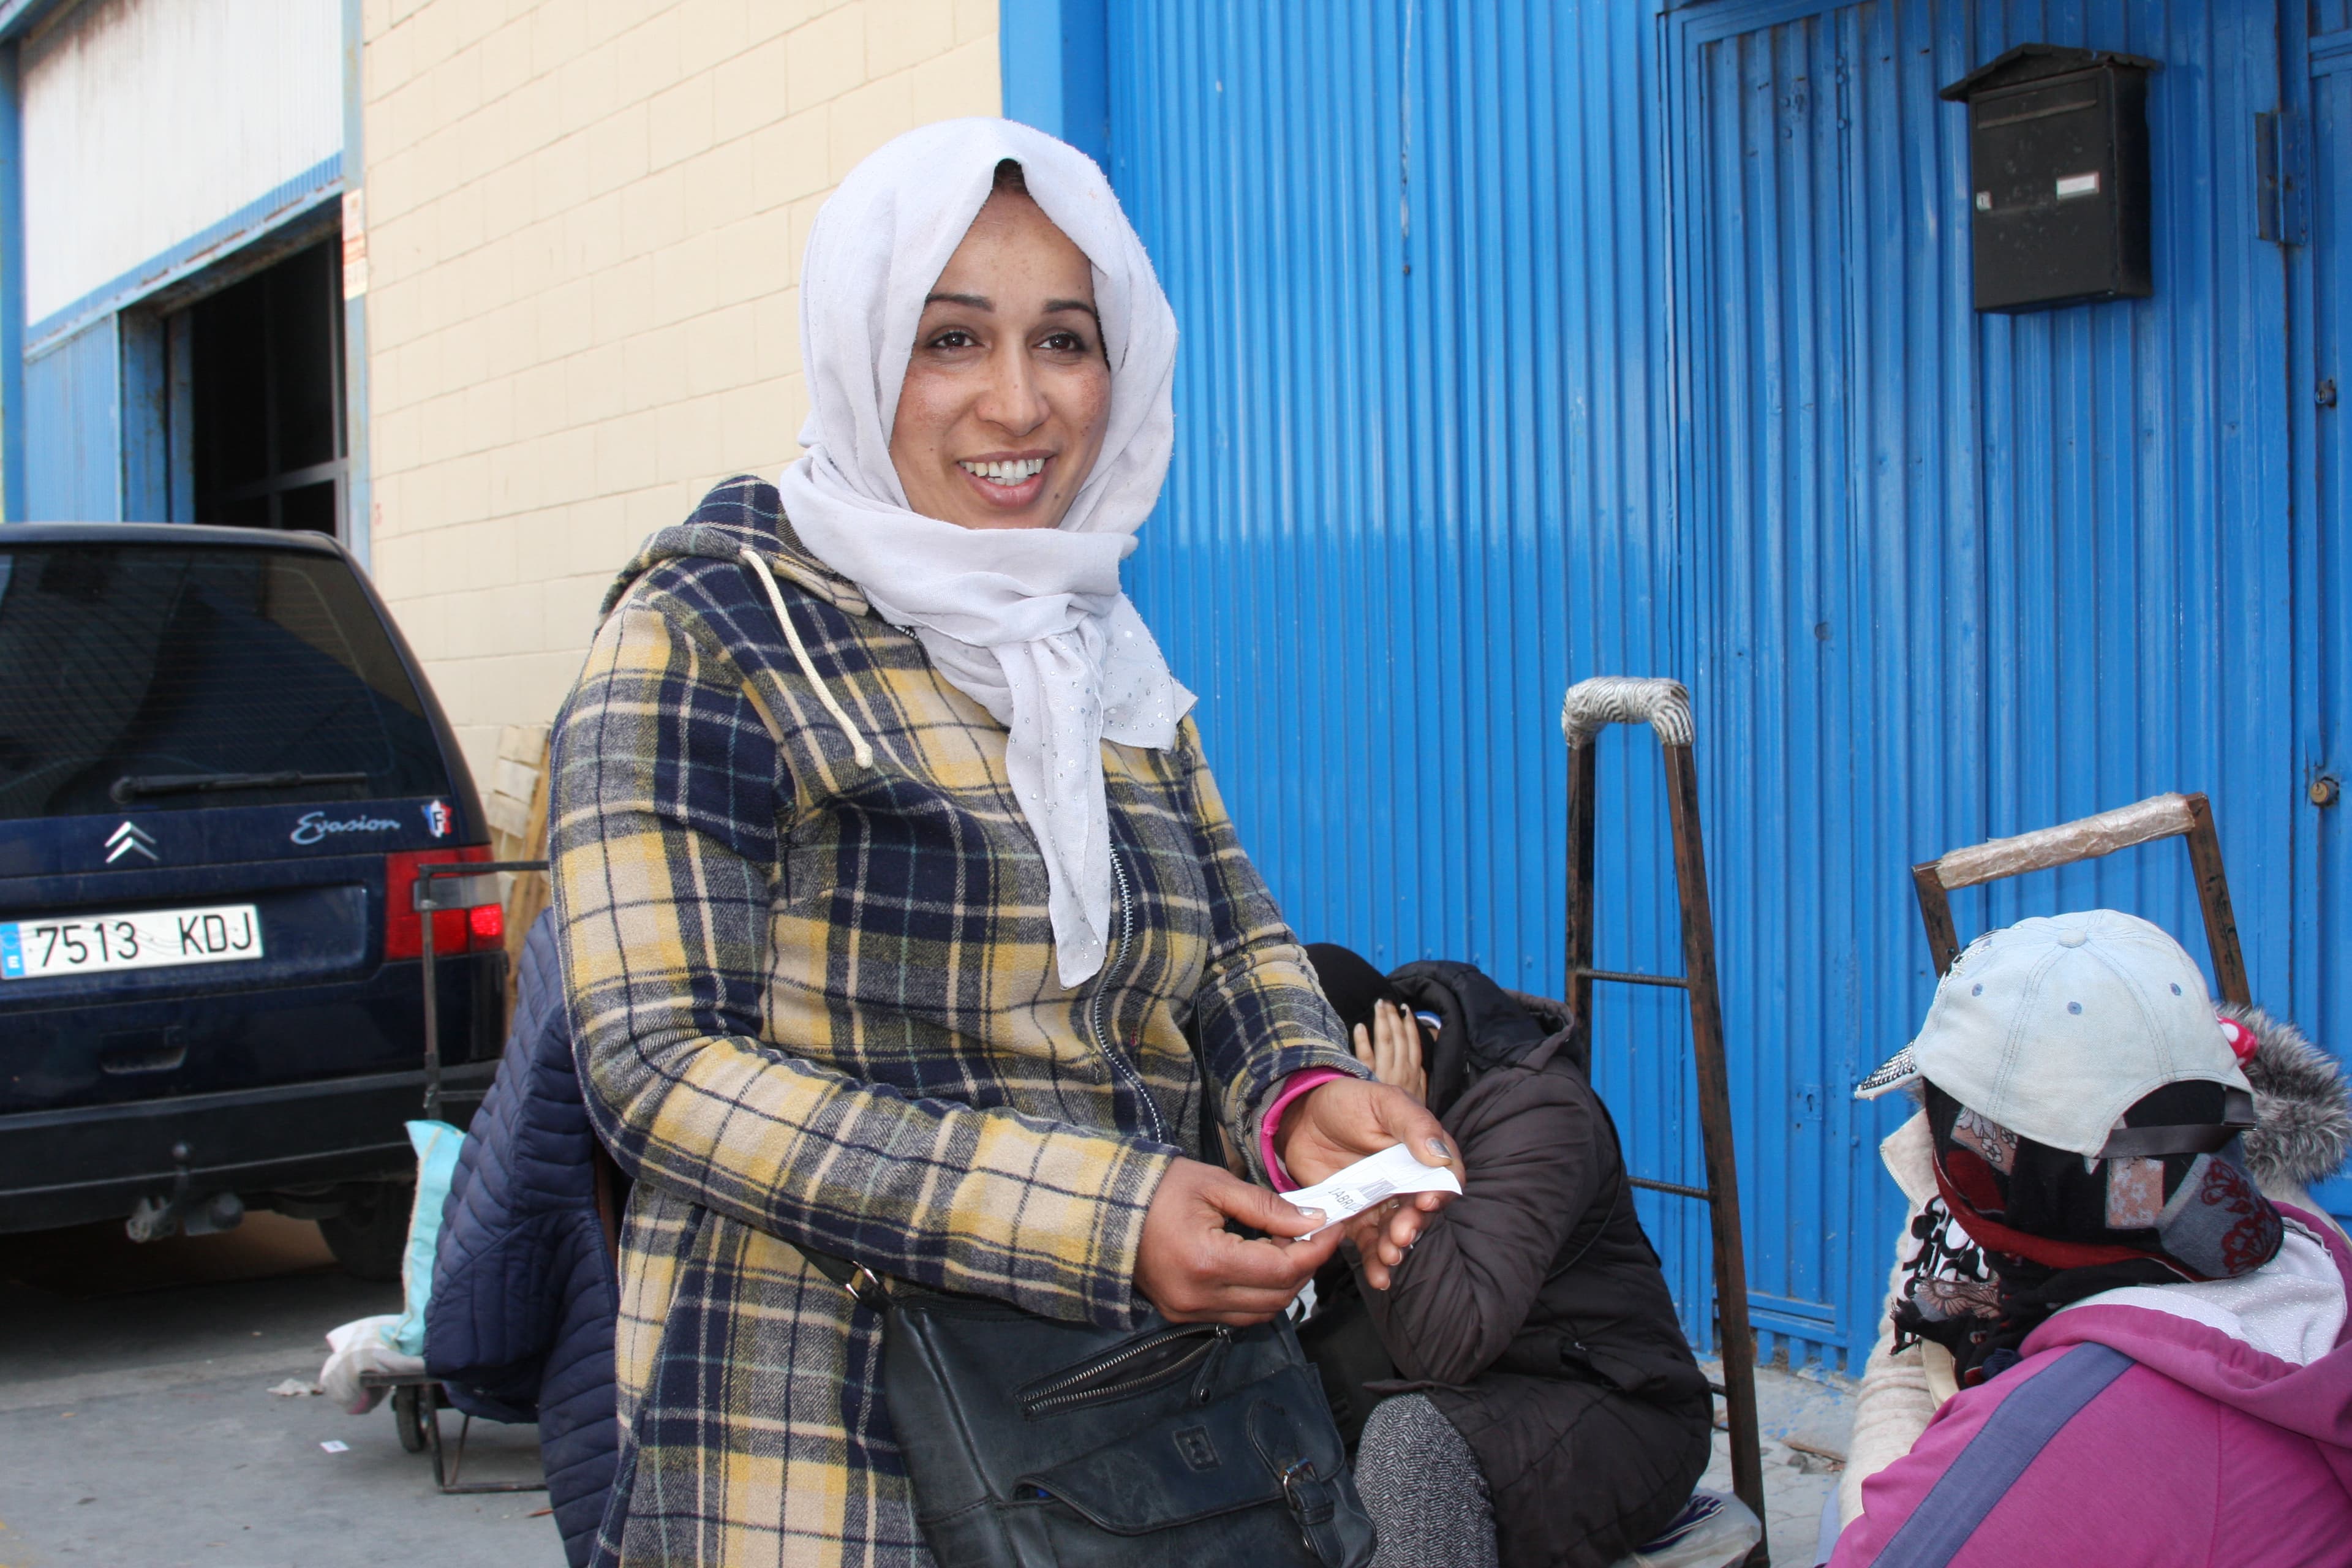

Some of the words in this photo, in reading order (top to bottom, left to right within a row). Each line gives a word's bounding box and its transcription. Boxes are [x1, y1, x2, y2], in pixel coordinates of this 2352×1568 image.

[290, 811, 401, 845] Evasion
[36, 922, 139, 967] 7513
[178, 912, 252, 956] KDJ
[7, 956, 20, 968] E
